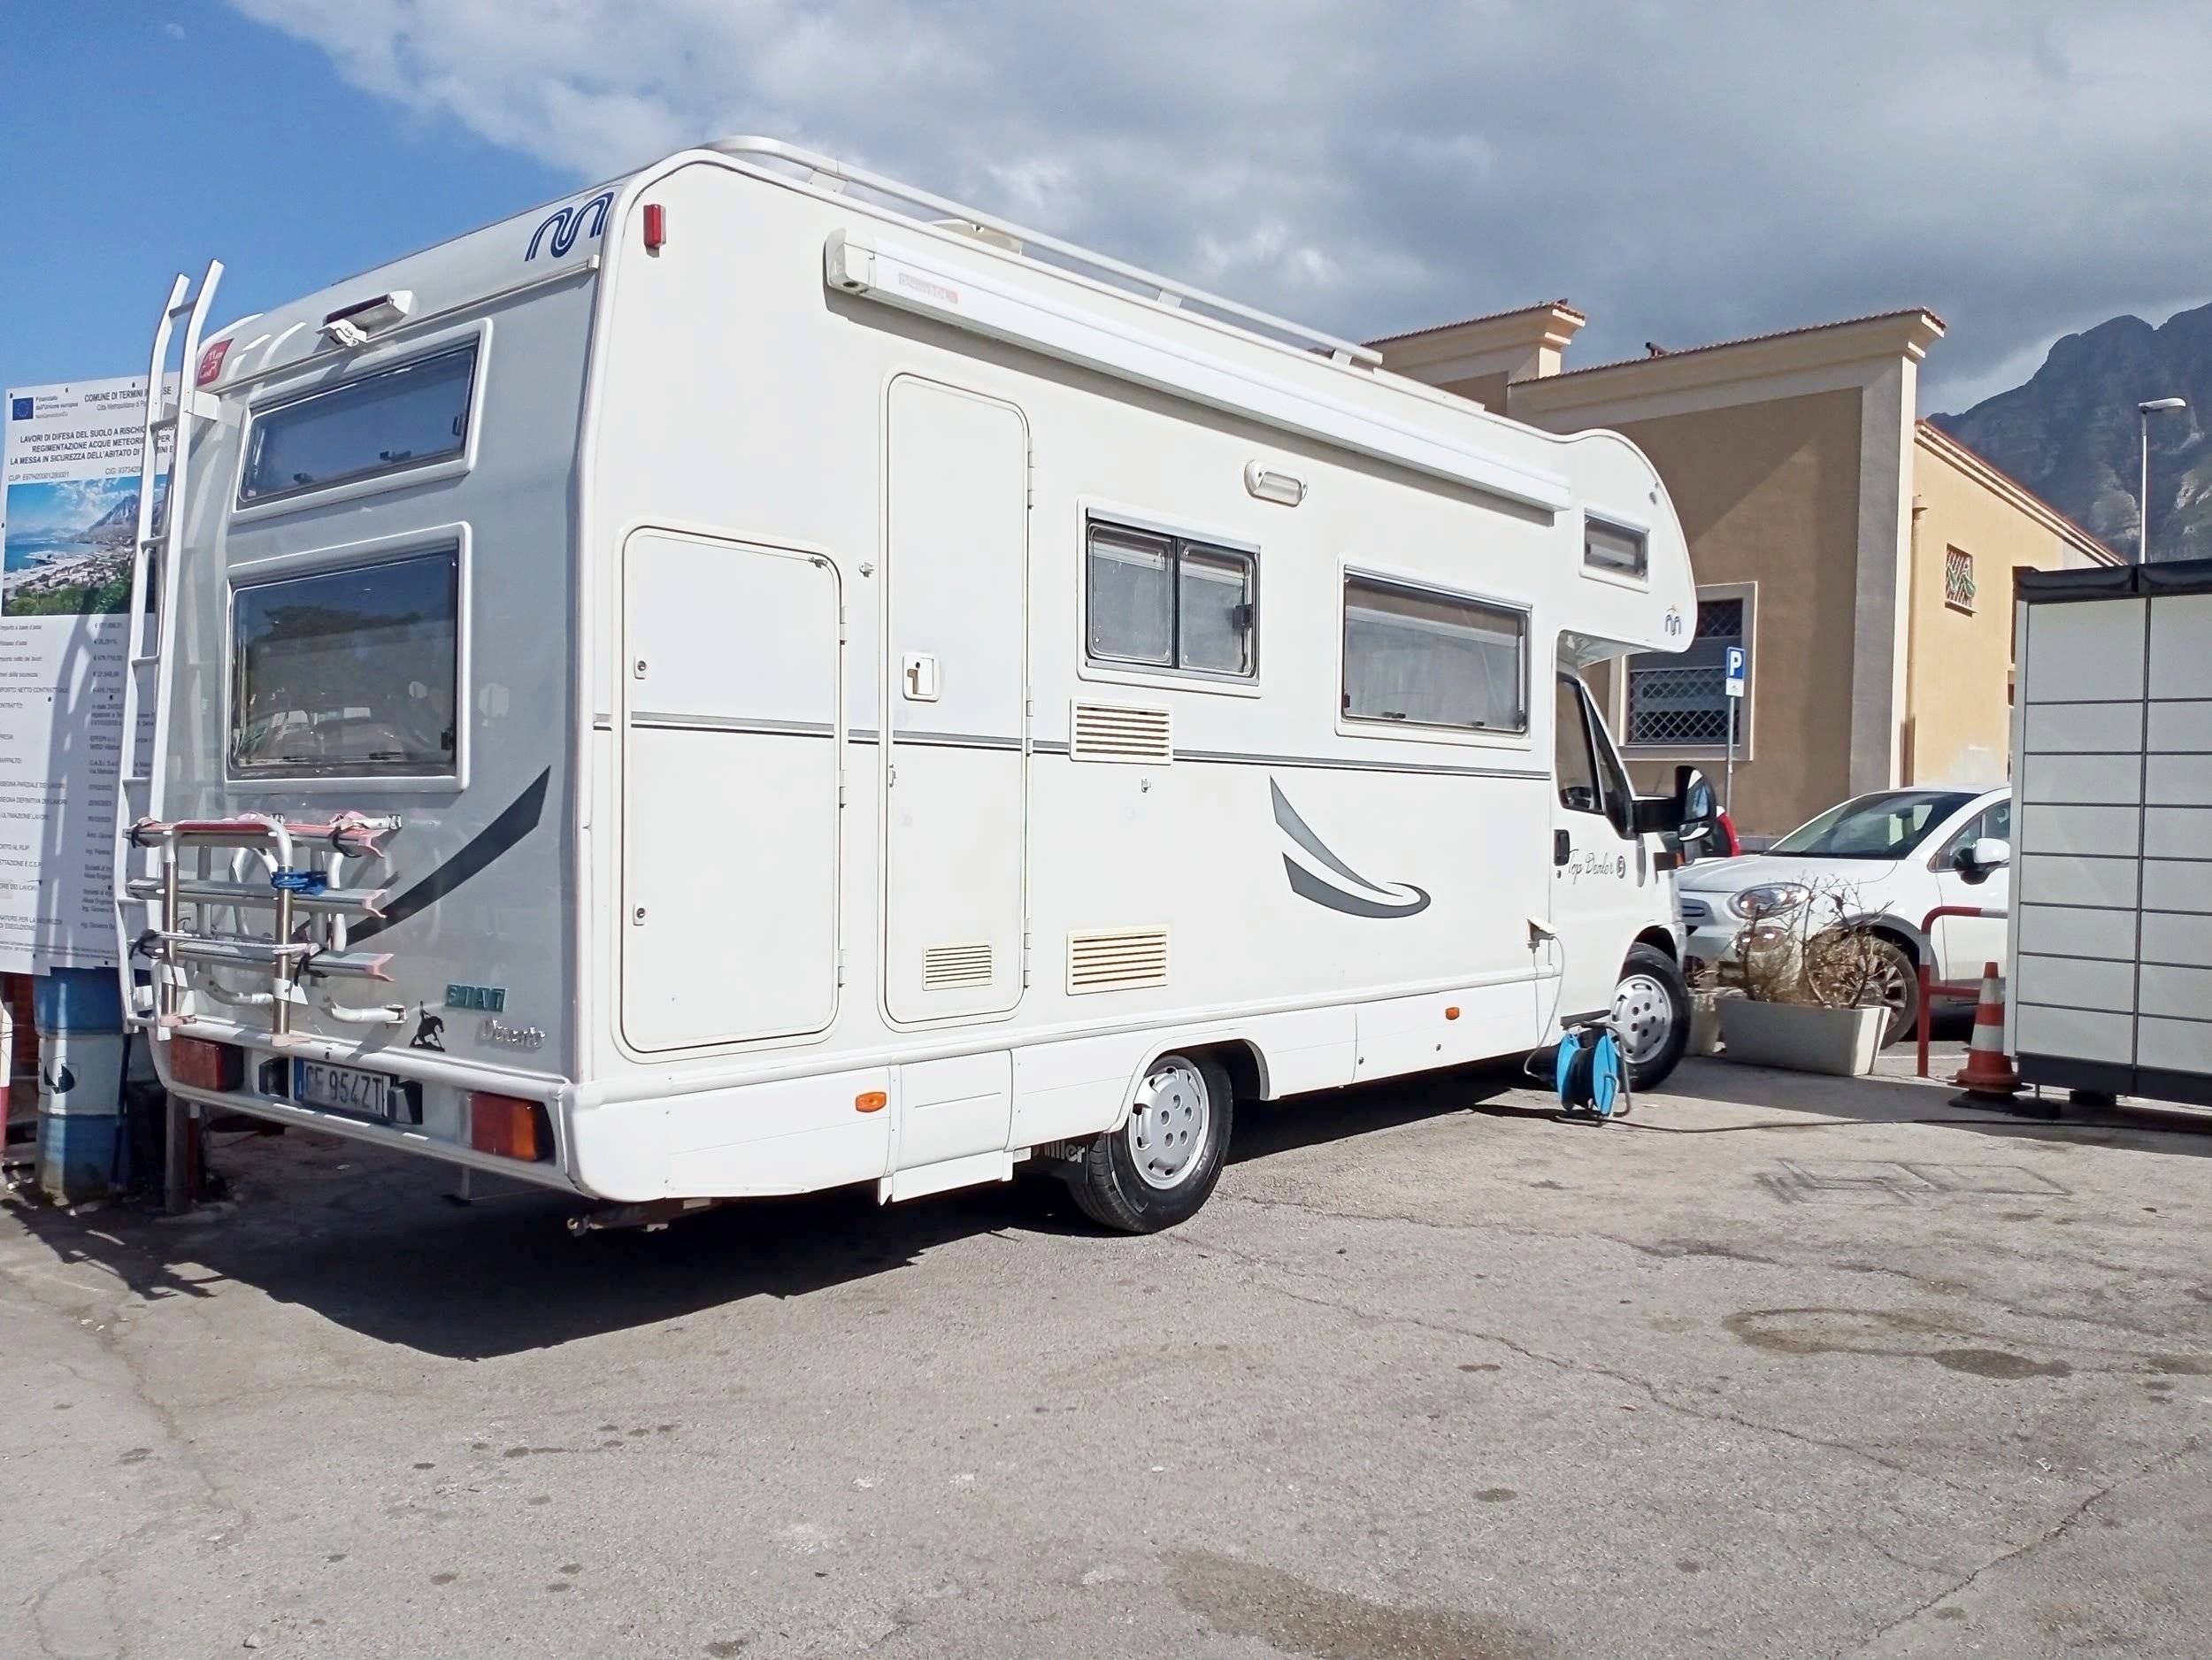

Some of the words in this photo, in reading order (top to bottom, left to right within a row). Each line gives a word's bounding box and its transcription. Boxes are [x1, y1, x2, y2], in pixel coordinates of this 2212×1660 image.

[84, 392, 110, 403] COMUNE
[111, 391, 118, 400] DI
[119, 389, 143, 399] TERMINI
[20, 434, 42, 443] LAVORI
[51, 432, 74, 441] DIFESA
[75, 430, 88, 439] DEL
[89, 428, 112, 437] SUOLO
[32, 442, 87, 453] REGIMENTAZIONE
[88, 440, 111, 449] ACQUE
[19, 456, 42, 465] MESSA
[50, 452, 86, 463] SICUREZZA
[87, 450, 132, 459] DELL'ABITATO
[1730, 650, 1742, 676] P
[1569, 849, 1583, 885] Top
[447, 986, 505, 1012] FIAT
